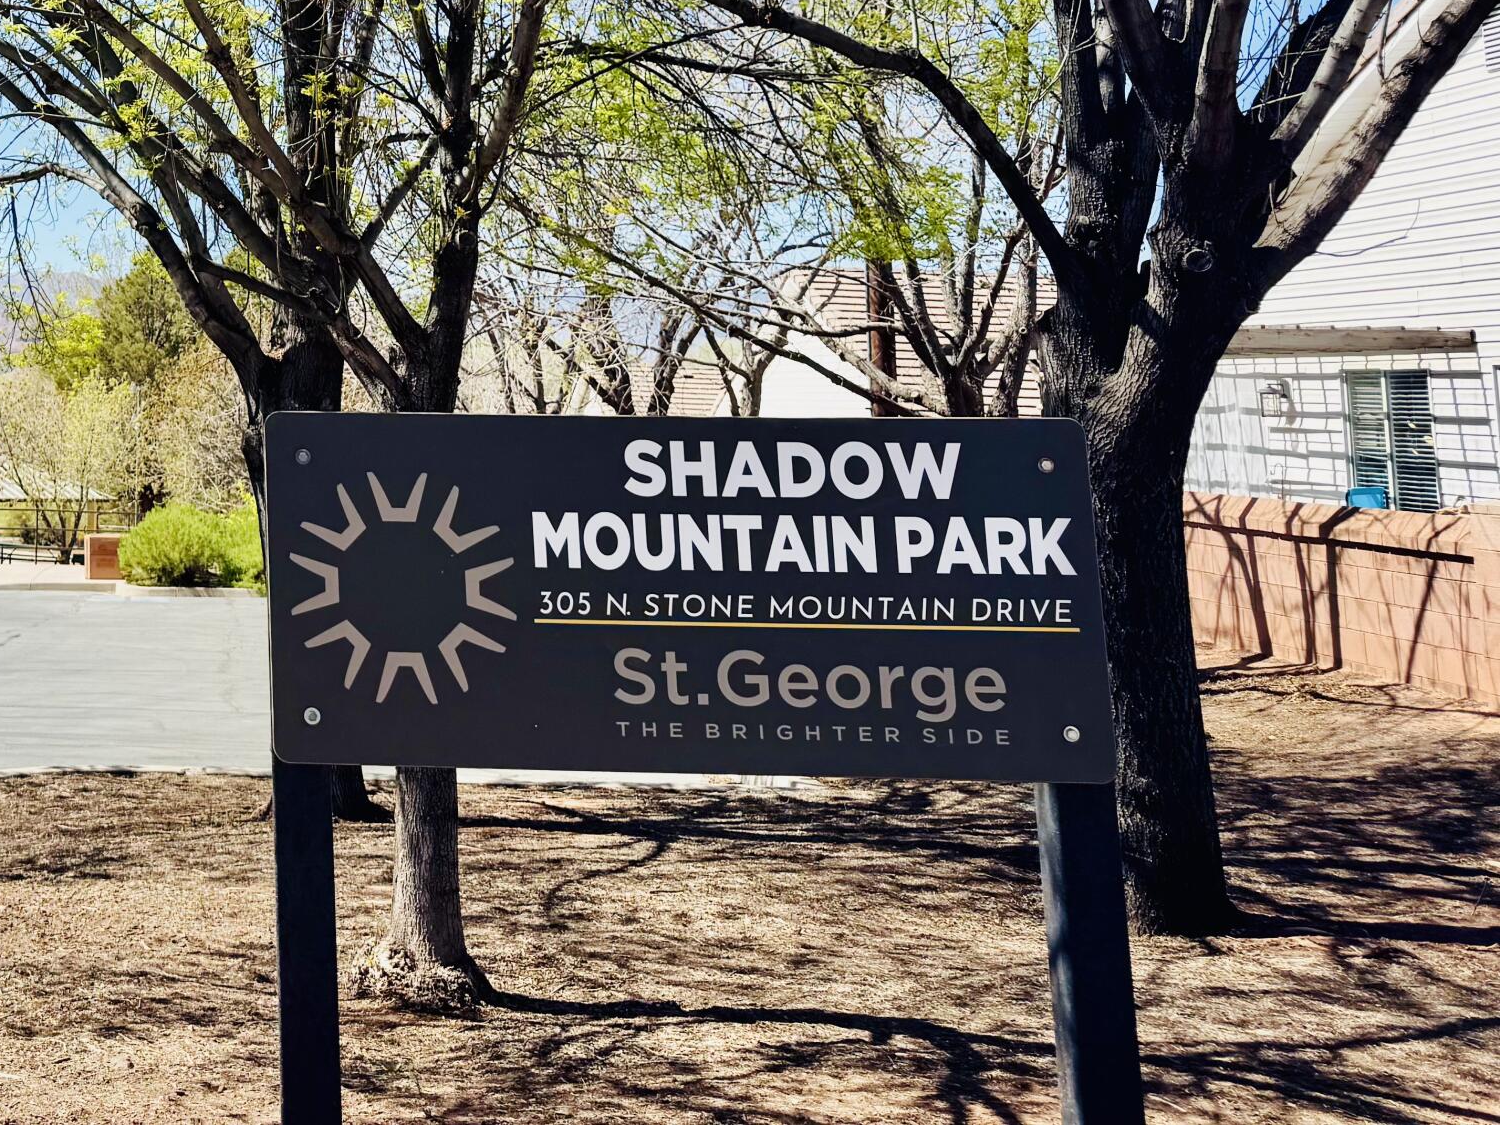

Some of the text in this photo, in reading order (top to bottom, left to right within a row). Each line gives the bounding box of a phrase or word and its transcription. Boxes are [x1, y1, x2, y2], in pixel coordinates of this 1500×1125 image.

[623, 440, 962, 499] SHADOW
[532, 512, 1077, 575] MOUNTAIN PARK
[540, 592, 1071, 622] 305 N. STONE MOUNTAIN DRIVE
[616, 722, 1010, 744] THE BRIGHTER SIDE
